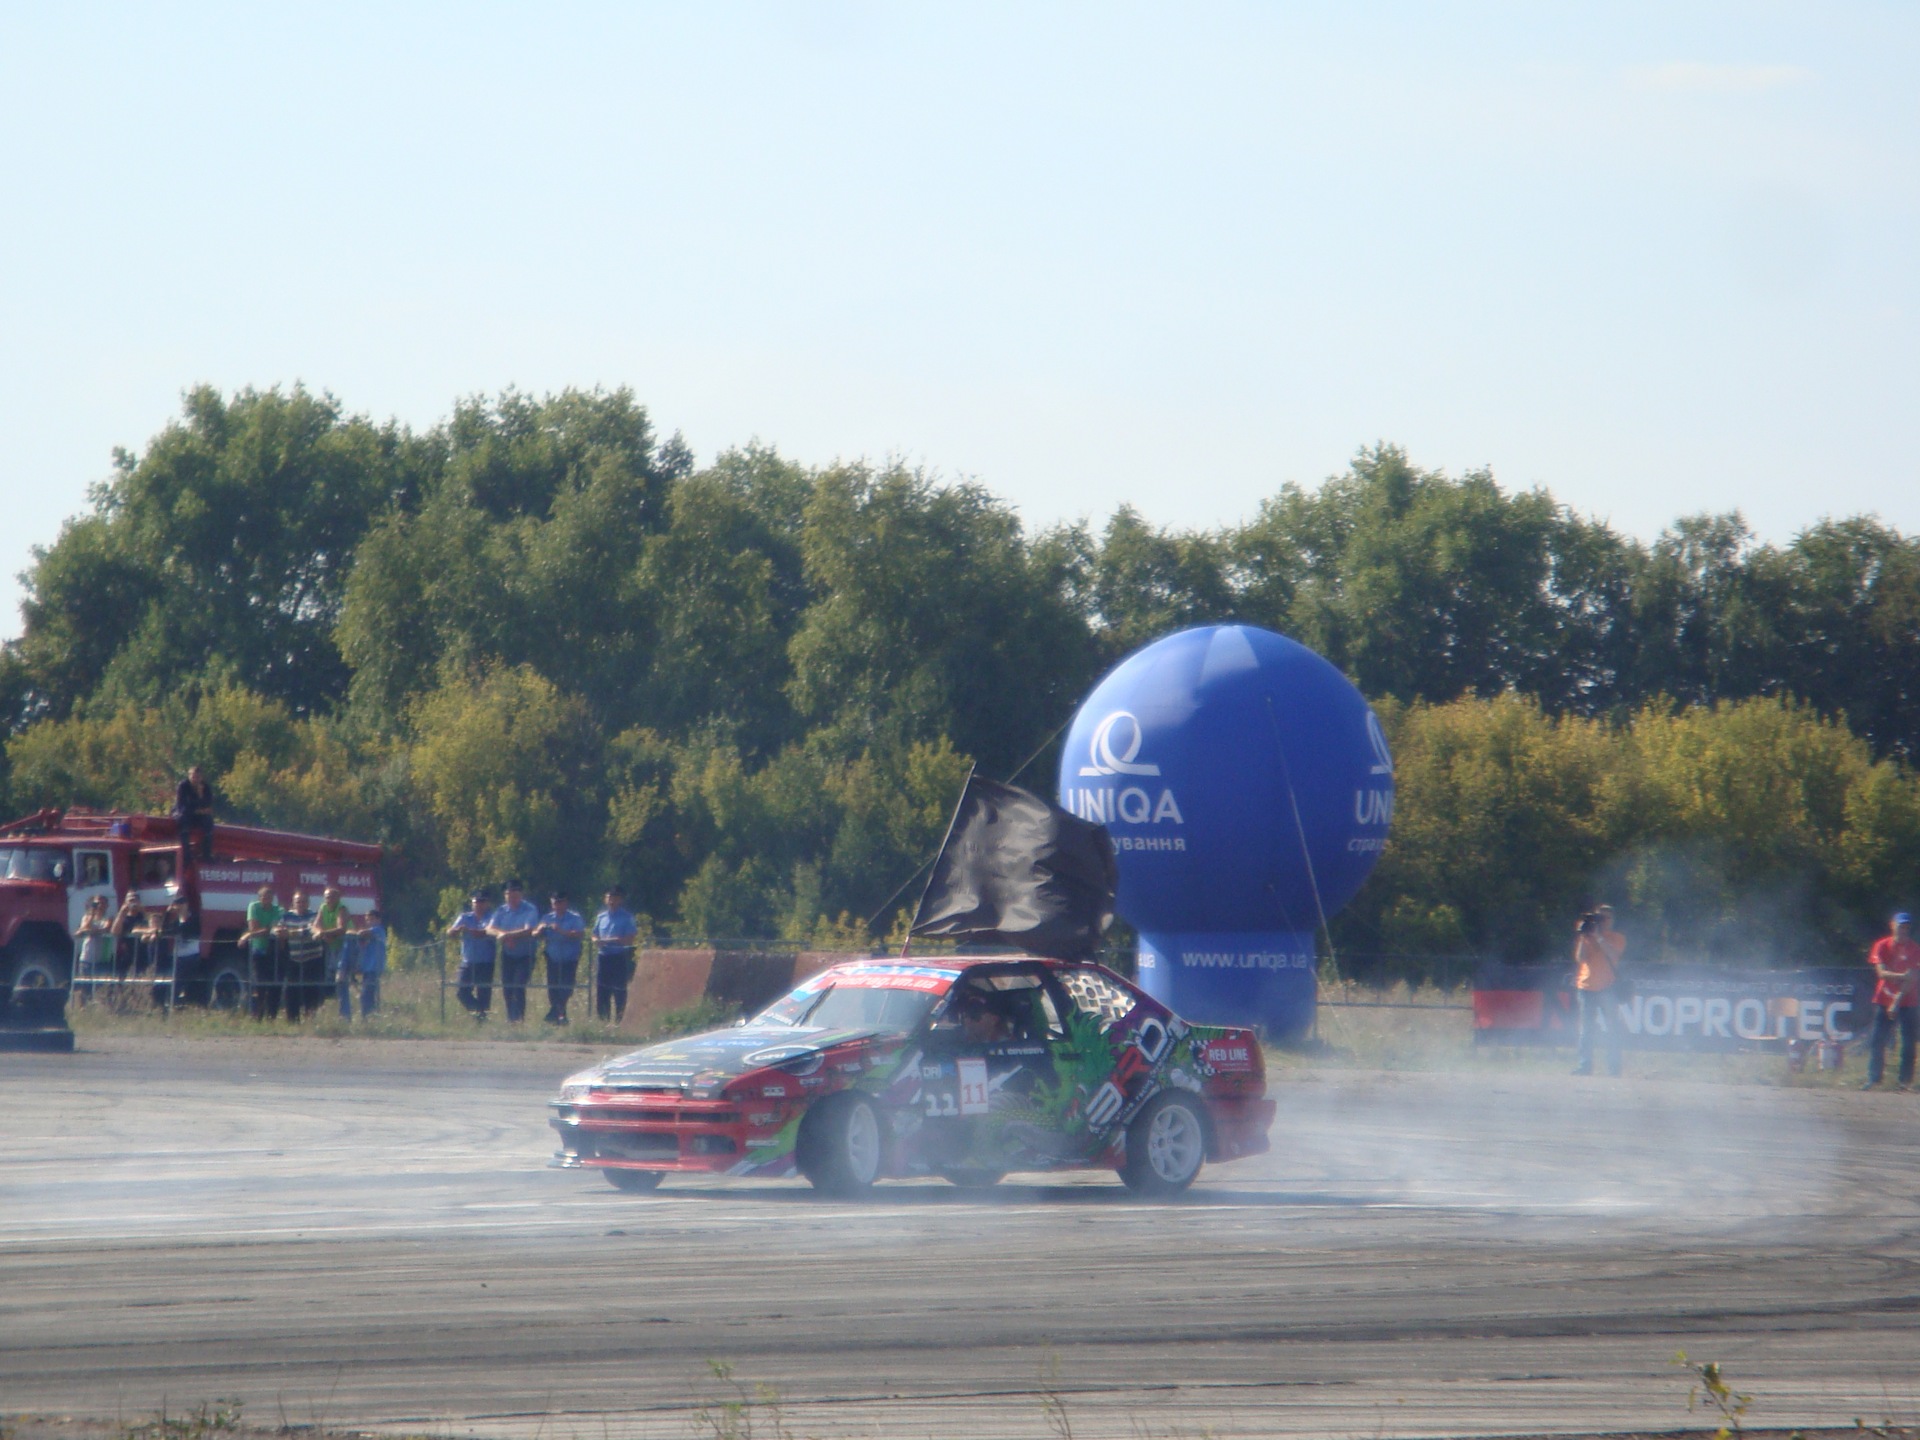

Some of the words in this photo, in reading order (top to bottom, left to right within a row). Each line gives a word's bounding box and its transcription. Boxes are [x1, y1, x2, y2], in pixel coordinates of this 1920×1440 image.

[1067, 787, 1184, 824] UNIQA
[1182, 952, 1307, 972] www.uniqa.ua
[1208, 1048, 1227, 1062] RED
[1228, 1048, 1249, 1062] LINE
[963, 1083, 987, 1105] 11
